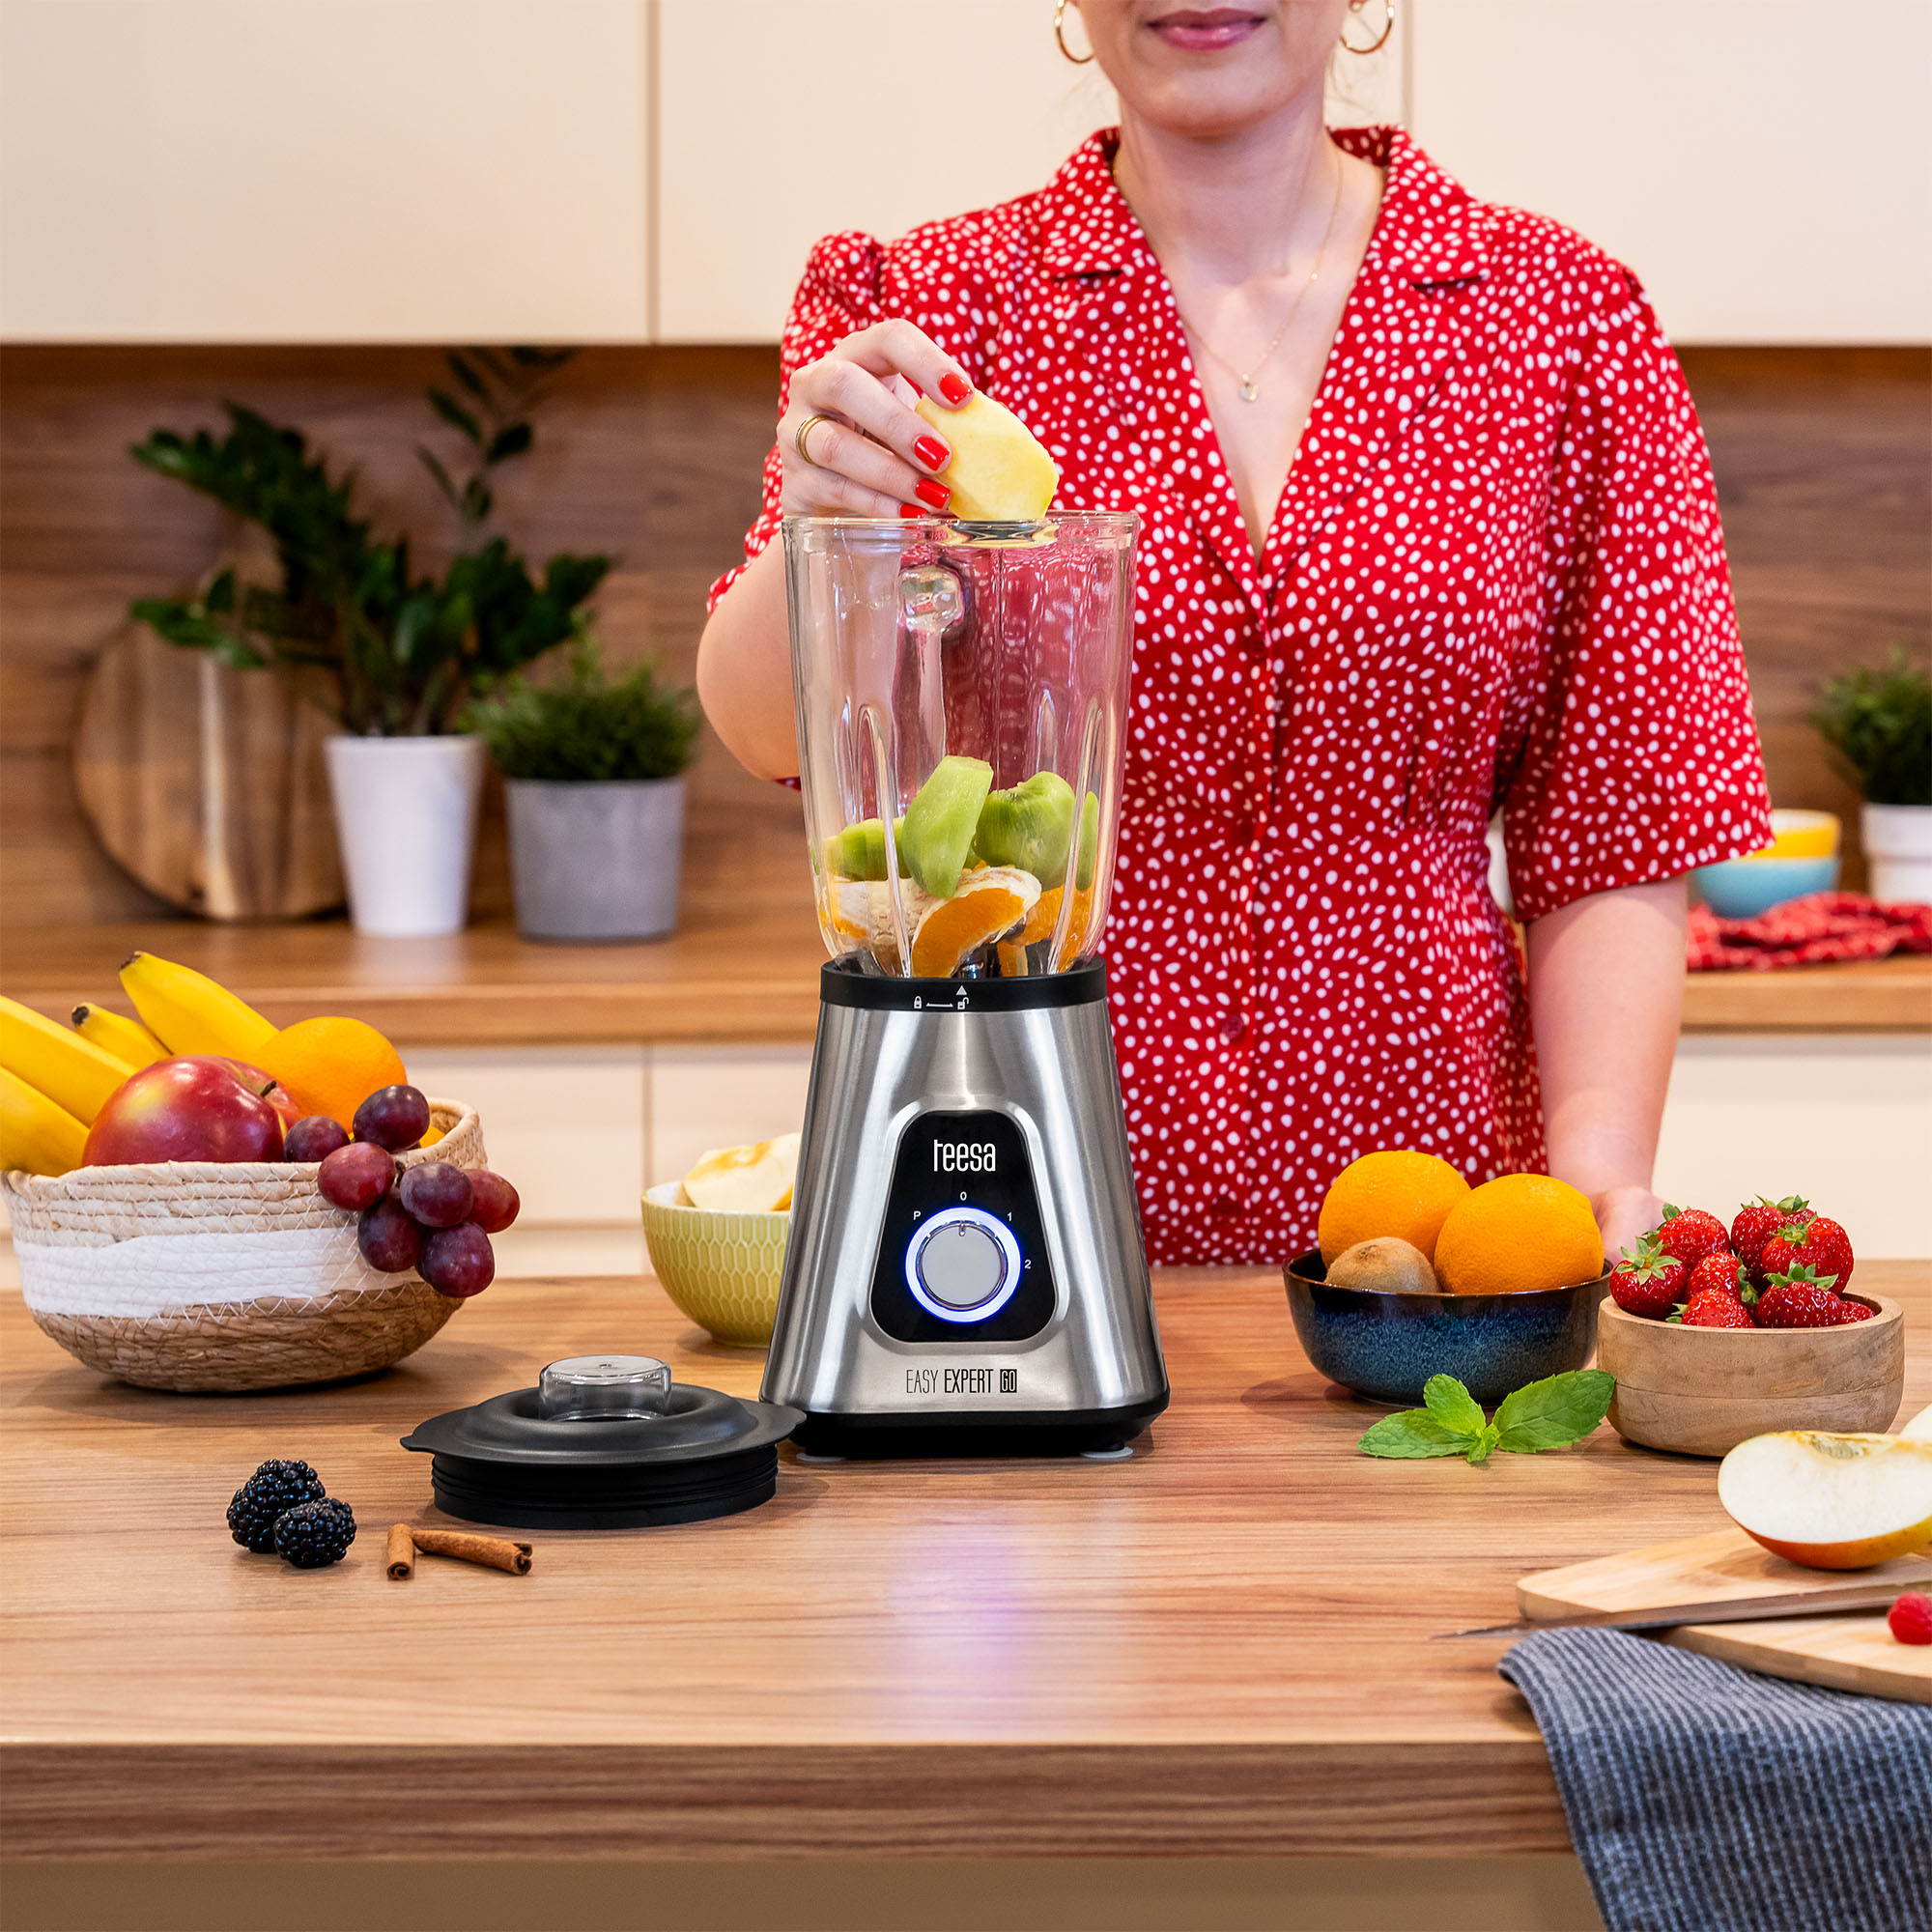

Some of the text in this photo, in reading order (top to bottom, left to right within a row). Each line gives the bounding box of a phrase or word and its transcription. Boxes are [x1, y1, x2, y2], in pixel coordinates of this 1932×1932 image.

[913, 1210, 922, 1221] P
[1007, 1211, 1013, 1222] 1
[1024, 1260, 1031, 1269] 2
[906, 1369, 1016, 1393] EASY EXPERT GO
